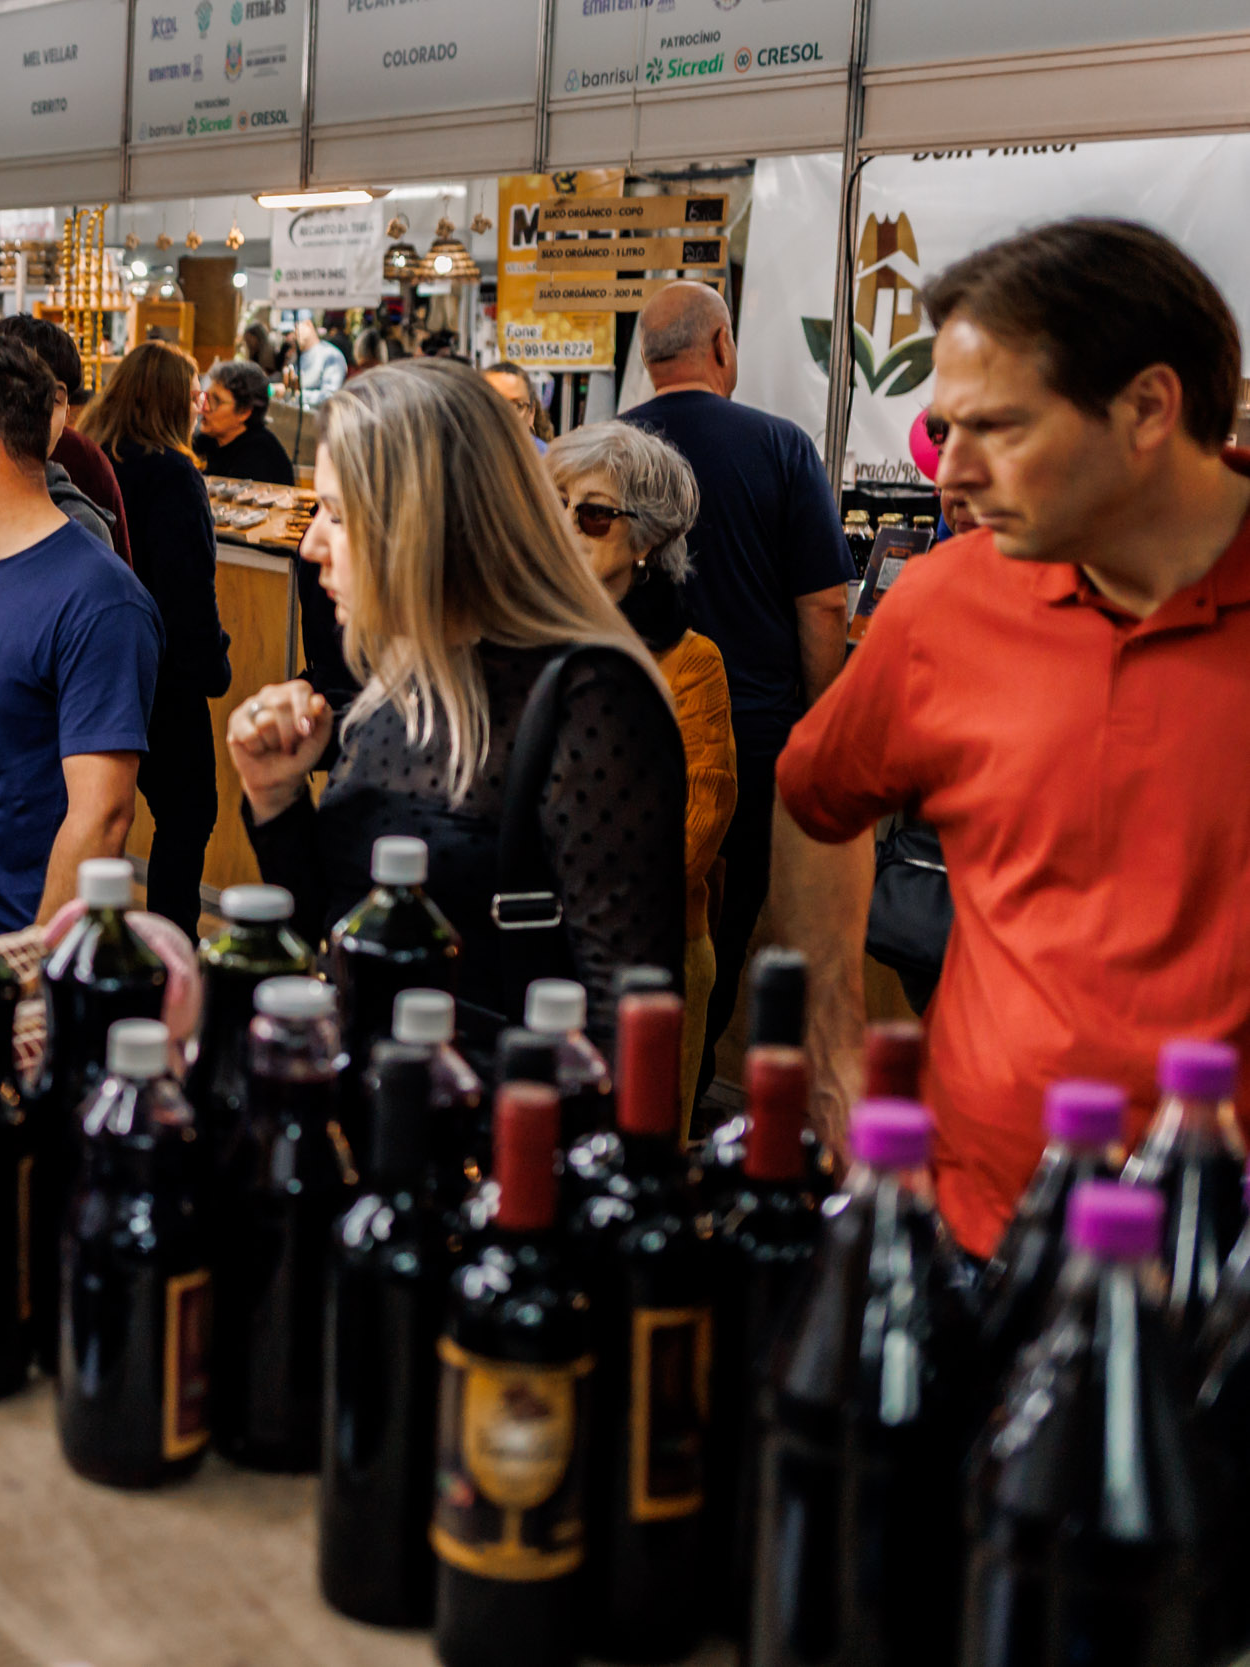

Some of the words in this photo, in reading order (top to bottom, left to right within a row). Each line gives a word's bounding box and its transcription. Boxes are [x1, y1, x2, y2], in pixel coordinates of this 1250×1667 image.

[660, 30, 721, 49] PATROCÍNIO
[23, 49, 41, 68] MEL
[43, 44, 78, 65] VELLAR
[383, 42, 457, 68] COLORADO
[582, 65, 639, 88] banrisul
[667, 53, 726, 79] Sicredi
[757, 42, 823, 67] CRESOL
[31, 97, 68, 115] CERRITO
[199, 115, 234, 133] Sicredi
[251, 109, 289, 127] CRESOL
[544, 208, 566, 219] SUCO
[568, 206, 612, 218] ORGÂNICO
[619, 207, 644, 217] COPO
[542, 249, 563, 259] SUCO
[565, 246, 609, 258] ORGÂNICO
[621, 247, 645, 257] LITRO
[539, 289, 561, 299] SUCO
[562, 286, 607, 298] ORGÂNICO
[613, 288, 630, 298] 300
[632, 288, 644, 297] ML
